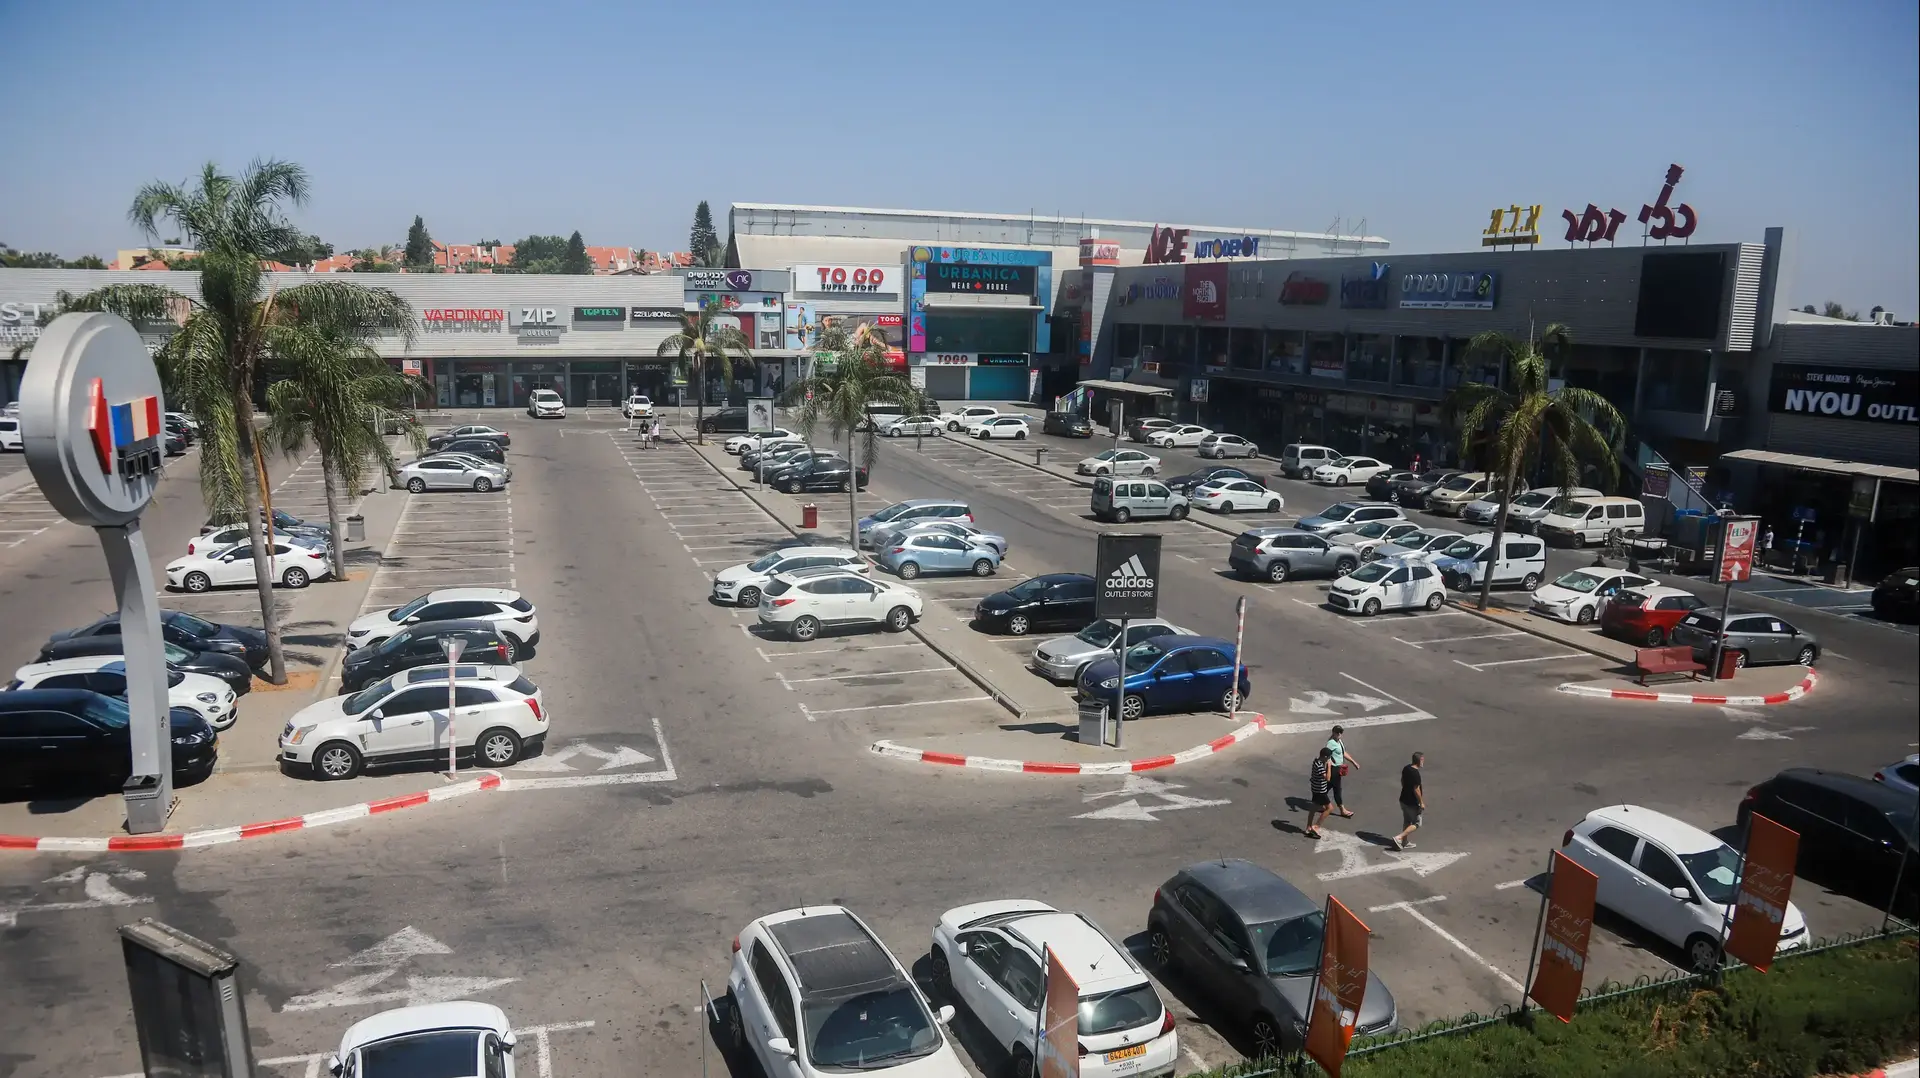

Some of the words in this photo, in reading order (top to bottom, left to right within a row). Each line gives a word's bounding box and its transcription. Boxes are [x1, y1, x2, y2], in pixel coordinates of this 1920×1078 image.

[1143, 223, 1190, 264] ACE
[951, 249, 1024, 264] URBANICA
[817, 267, 847, 284] TO
[853, 268, 884, 285] GO
[939, 265, 1020, 281] URBANICA
[821, 284, 848, 292] SUPER
[851, 284, 878, 292] STORE
[951, 281, 970, 290] WEAR
[1199, 280, 1210, 288] THE
[1192, 288, 1210, 296] NORTH
[1196, 295, 1210, 303] FACE
[423, 309, 504, 321] VARDINON
[522, 307, 557, 322] ZIP
[526, 329, 553, 337] OUTLET
[936, 354, 968, 365] TOGO
[1806, 372, 1824, 382] STEVE
[1825, 374, 1850, 384] MADDEN
[1785, 388, 1862, 417] NYOU
[1105, 575, 1154, 588] adidas
